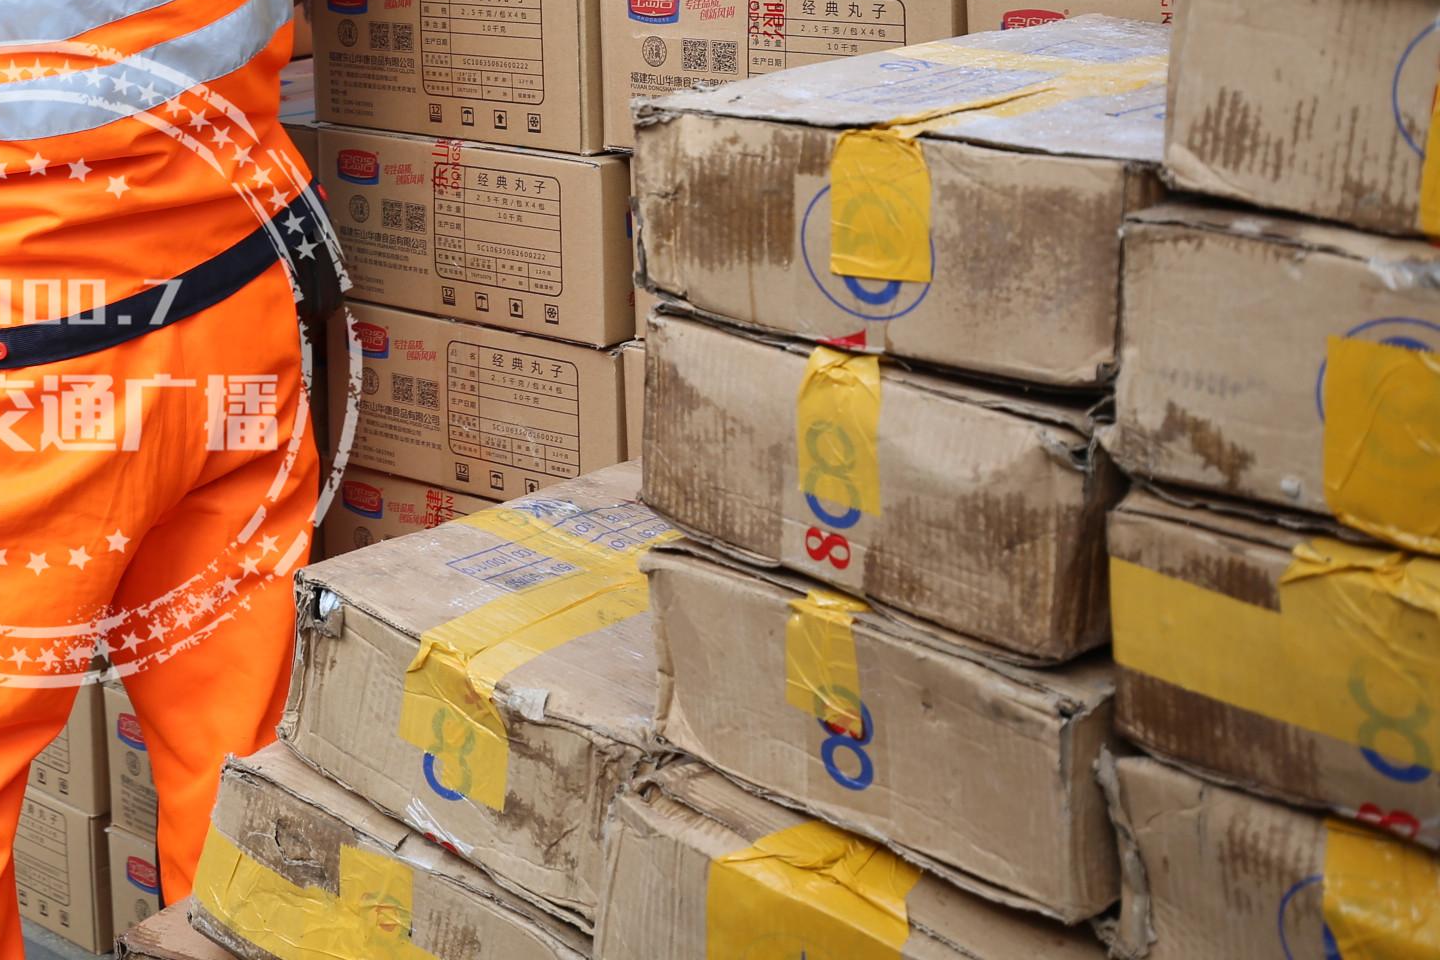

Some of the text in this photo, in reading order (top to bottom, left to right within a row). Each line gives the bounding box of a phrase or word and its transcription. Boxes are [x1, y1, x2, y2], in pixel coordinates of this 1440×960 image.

[700, 6, 736, 21] 创新风尚
[801, 0, 887, 20] 经典丸子
[482, 24, 507, 34] 10千克
[826, 42, 859, 53] 10千克
[752, 56, 783, 67] 生产日期
[477, 173, 546, 194] 经典丸子
[497, 211, 523, 223] 10千克
[492, 353, 564, 379] 经典丸子
[513, 393, 540, 405] 10千克
